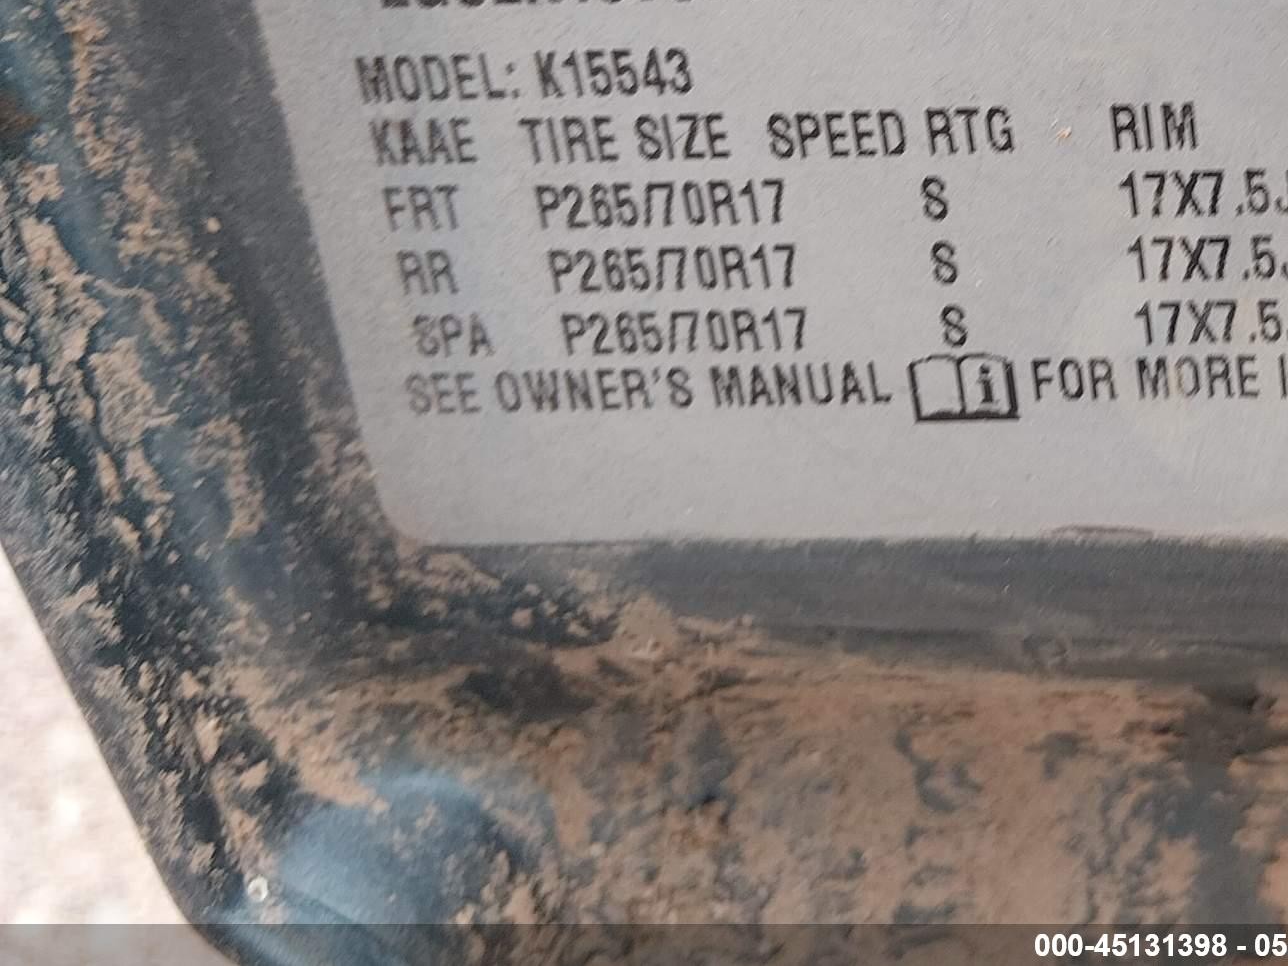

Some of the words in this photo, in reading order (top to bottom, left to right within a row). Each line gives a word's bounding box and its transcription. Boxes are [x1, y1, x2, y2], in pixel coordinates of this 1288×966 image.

[355, 54, 520, 105] MODEL:
[534, 47, 694, 99] K15543
[369, 117, 479, 166] KAAE
[519, 114, 620, 165] TIRE
[634, 111, 733, 162] SIZE
[767, 108, 906, 160] SPEED
[926, 105, 1015, 155] RTG
[1110, 102, 1200, 152] RIM
[384, 185, 459, 232] FRT
[534, 178, 786, 230] P265/70R17
[921, 175, 949, 221] S
[401, 250, 458, 295] RR
[549, 244, 797, 293] P265/70R17
[931, 240, 959, 286] S
[412, 314, 495, 358] SPA
[559, 306, 806, 355] P265/70R17
[940, 303, 968, 348] S
[404, 372, 481, 416] SEE
[499, 367, 694, 413] OWNER'S
[711, 360, 893, 408] MANUAL
[1031, 353, 1118, 402] FOR
[1136, 353, 1261, 400] MORE
